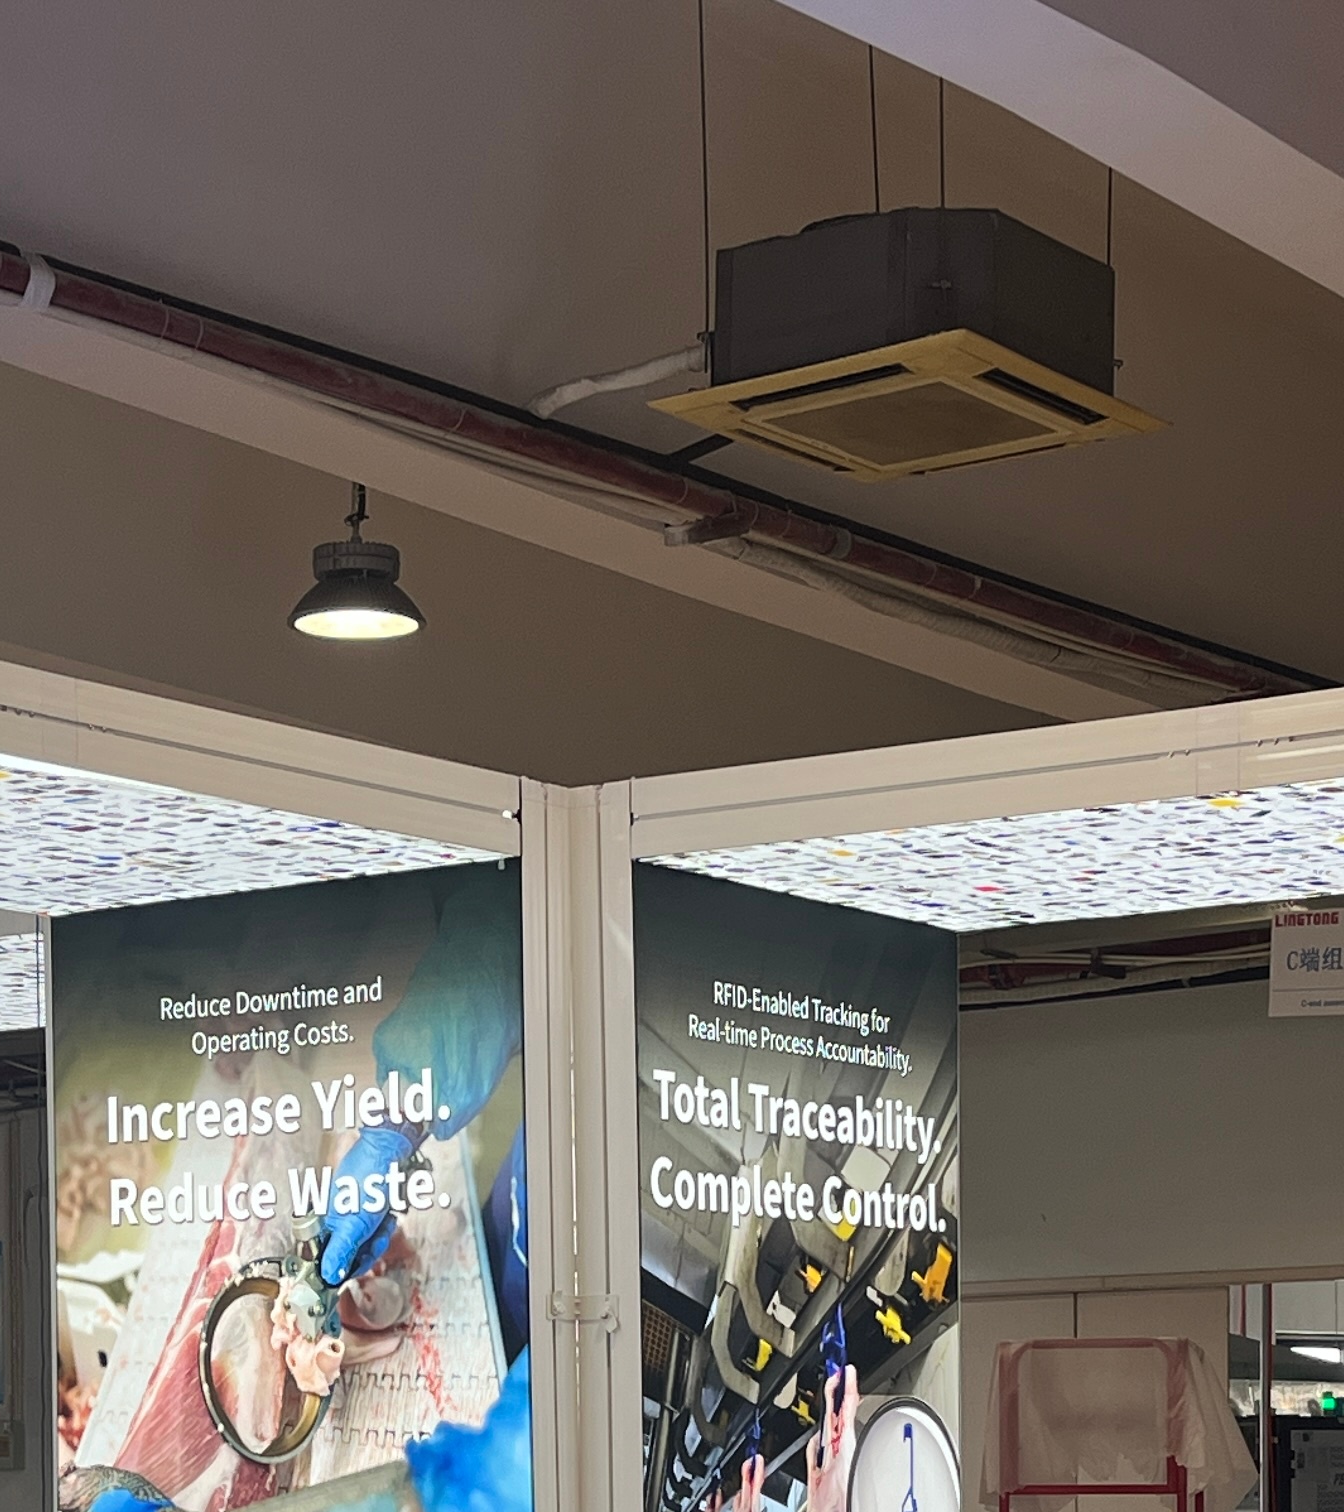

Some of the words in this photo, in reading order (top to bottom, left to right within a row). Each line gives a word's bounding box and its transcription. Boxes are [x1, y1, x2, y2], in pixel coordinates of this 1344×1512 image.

[1275, 912, 1339, 927] LINGTONG
[159, 997, 231, 1020] Reduce
[236, 983, 338, 1014] Downtime
[343, 976, 382, 1004] and
[714, 981, 809, 1020] RFID-Enabled
[812, 998, 869, 1036] Tracking
[871, 1008, 890, 1034] for
[191, 1026, 290, 1059] Operating
[294, 1019, 354, 1046] Costs.
[689, 1014, 757, 1048] Real-time
[761, 1026, 814, 1057] Process
[816, 1036, 913, 1077] Accountability.
[107, 1093, 301, 1143] Increase
[311, 1068, 452, 1130] Yield.
[653, 1069, 741, 1131] Total
[748, 1083, 942, 1164] Traceability.
[110, 1170, 276, 1226] Reduce
[289, 1161, 452, 1217] Waste.
[651, 1156, 814, 1227] Complete
[823, 1175, 946, 1233] Control.
